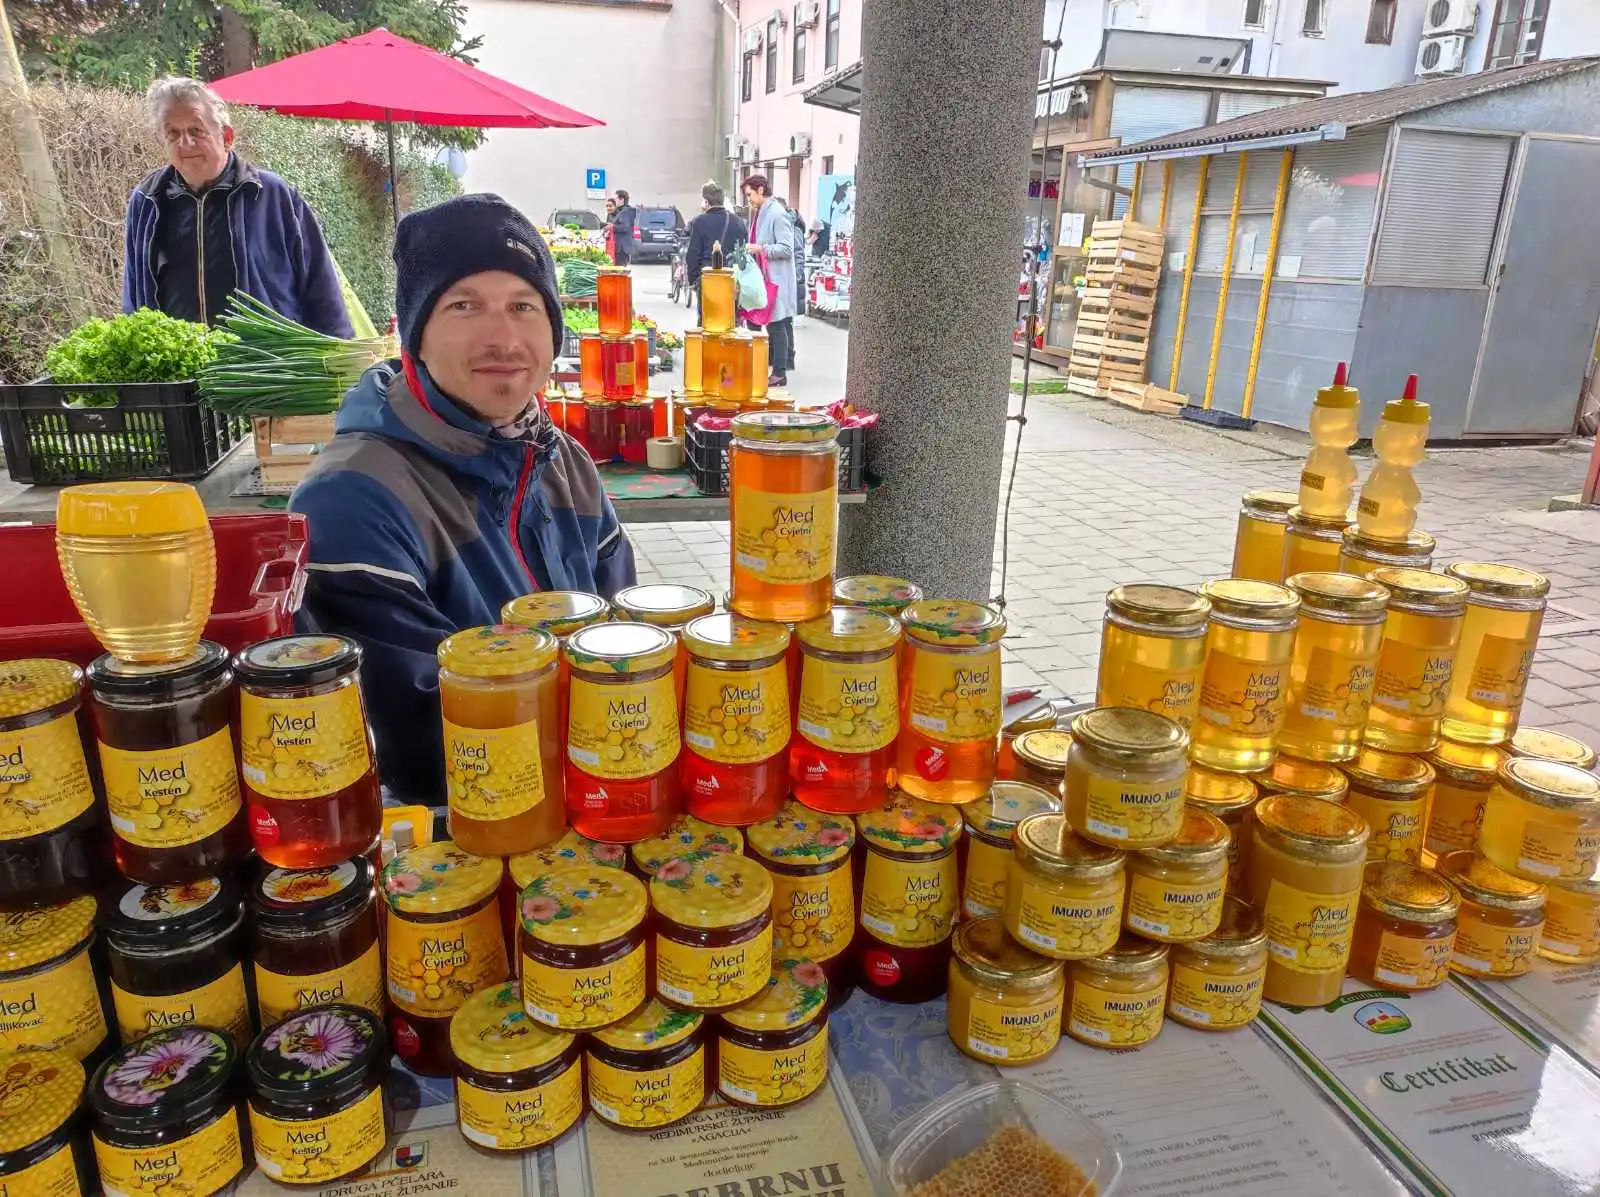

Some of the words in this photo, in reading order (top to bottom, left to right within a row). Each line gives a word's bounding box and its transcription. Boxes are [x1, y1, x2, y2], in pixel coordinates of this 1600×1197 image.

[591, 172, 600, 185] P
[775, 505, 815, 523] Med
[957, 664, 990, 683] Med
[1248, 672, 1280, 686] Med
[723, 680, 761, 700] Med
[841, 675, 877, 693] Med
[608, 696, 647, 715] Med
[271, 711, 316, 731] Med
[611, 719, 645, 729] Cvjetni
[276, 736, 312, 746] Kesten
[452, 740, 487, 759] Med
[0, 745, 24, 767] ed
[455, 759, 485, 771] Cvjetni
[138, 761, 187, 783] Med
[144, 786, 182, 798] Kesten
[1120, 792, 1162, 805] IMUNO
[905, 872, 940, 891] Med
[792, 885, 829, 906] Med
[908, 893, 939, 904] Cvjetni
[1163, 892, 1203, 904] IMUNO
[1051, 904, 1092, 918] IMUNO
[1316, 904, 1350, 921] Med
[423, 933, 465, 954] Med
[424, 953, 467, 969] Cvjetni
[710, 949, 745, 969] Med
[574, 969, 612, 990] Med
[1204, 982, 1243, 994] IMUNO
[299, 980, 344, 1005] Med
[148, 1004, 196, 1026] Med
[1104, 1001, 1144, 1012] IMUNO
[1000, 1013, 1040, 1026] IMUNO
[773, 1049, 806, 1069] Med
[633, 1073, 671, 1091] Med
[1379, 1053, 1518, 1094] Certifikat
[505, 1093, 542, 1113] Med
[286, 1126, 326, 1144] Med
[291, 1146, 323, 1156] Kesten
[134, 1151, 178, 1172] Med
[381, 1170, 446, 1187] PČELARA
[658, 1162, 846, 1197] EBRNU
